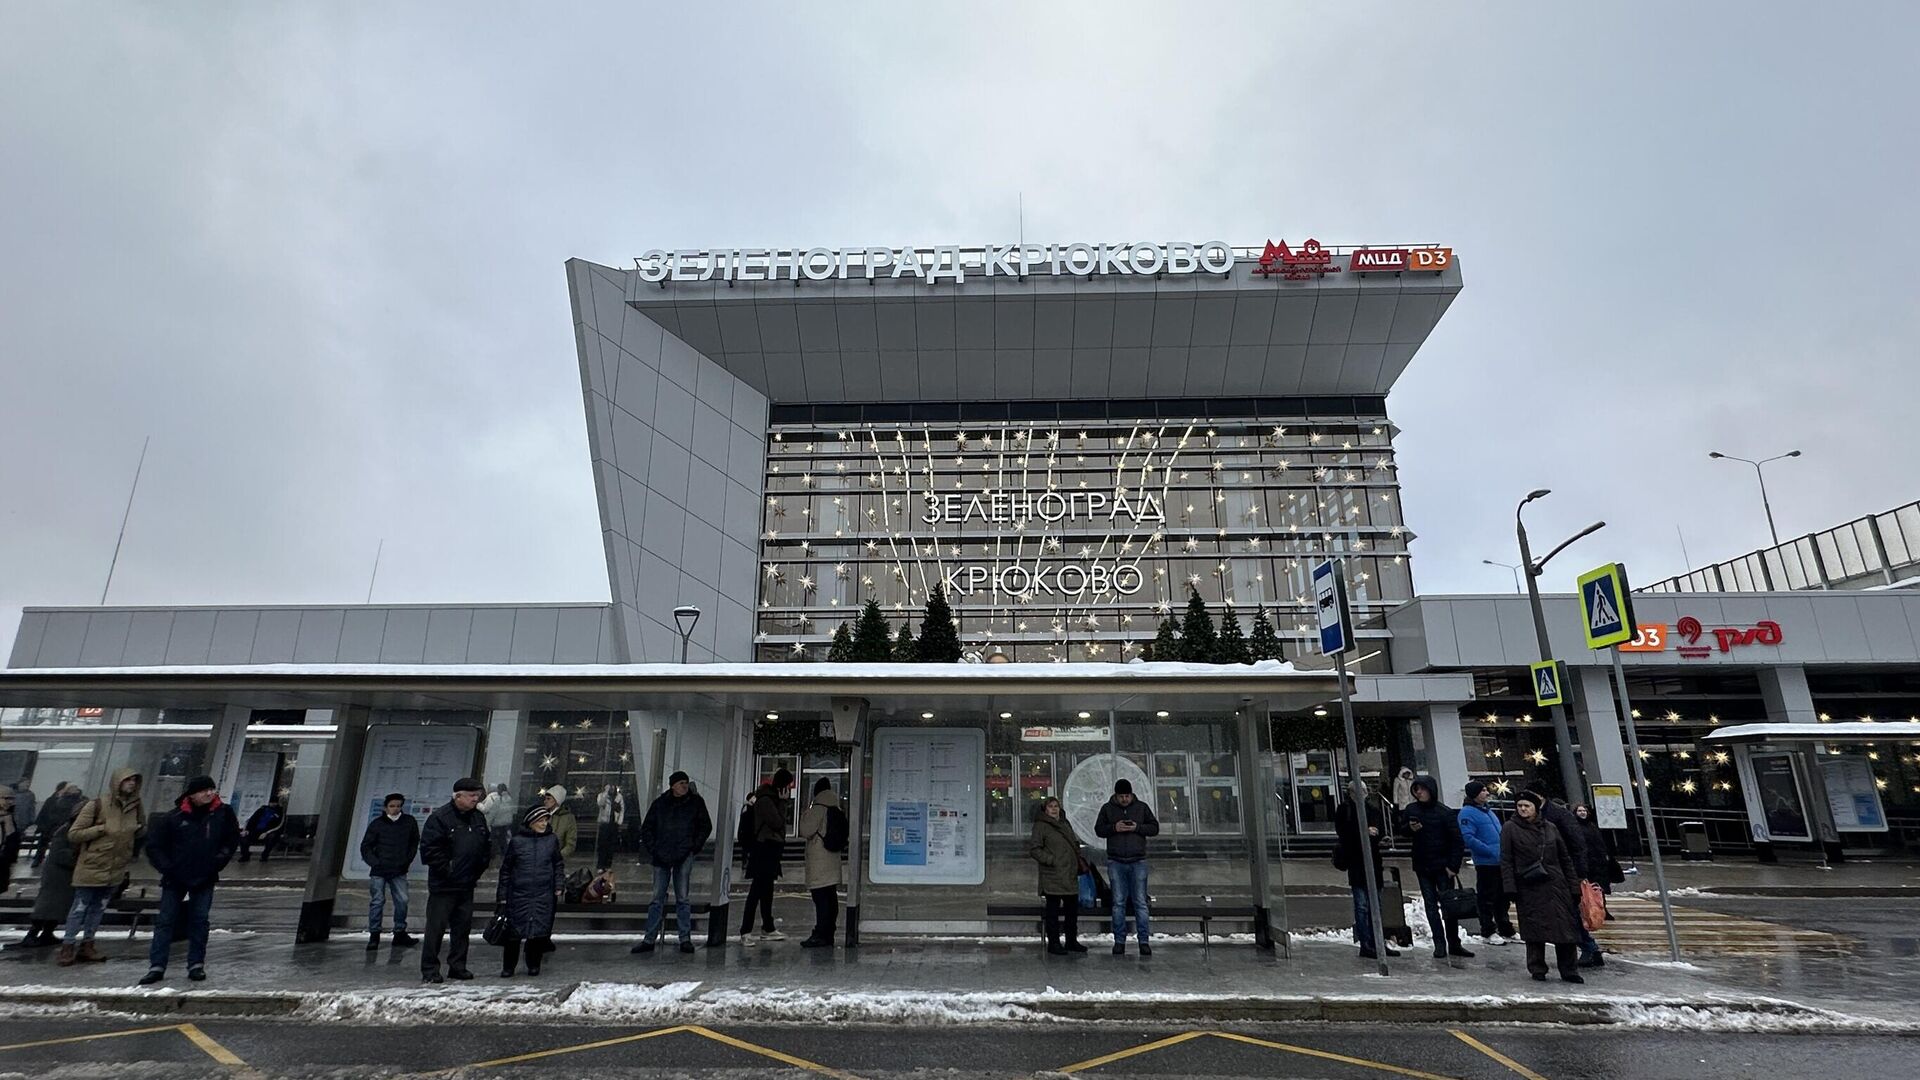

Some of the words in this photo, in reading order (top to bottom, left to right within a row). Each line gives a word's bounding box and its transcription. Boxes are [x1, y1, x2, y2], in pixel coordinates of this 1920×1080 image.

[638, 240, 1235, 285] ЗЕЛЕНОГРАД-КРЮКОВО
[1357, 251, 1403, 266] МЦД
[1416, 250, 1447, 266] D3
[921, 491, 1166, 525] ЗЕЛЕНОГРАД
[945, 564, 1145, 596] КРЮКОВО
